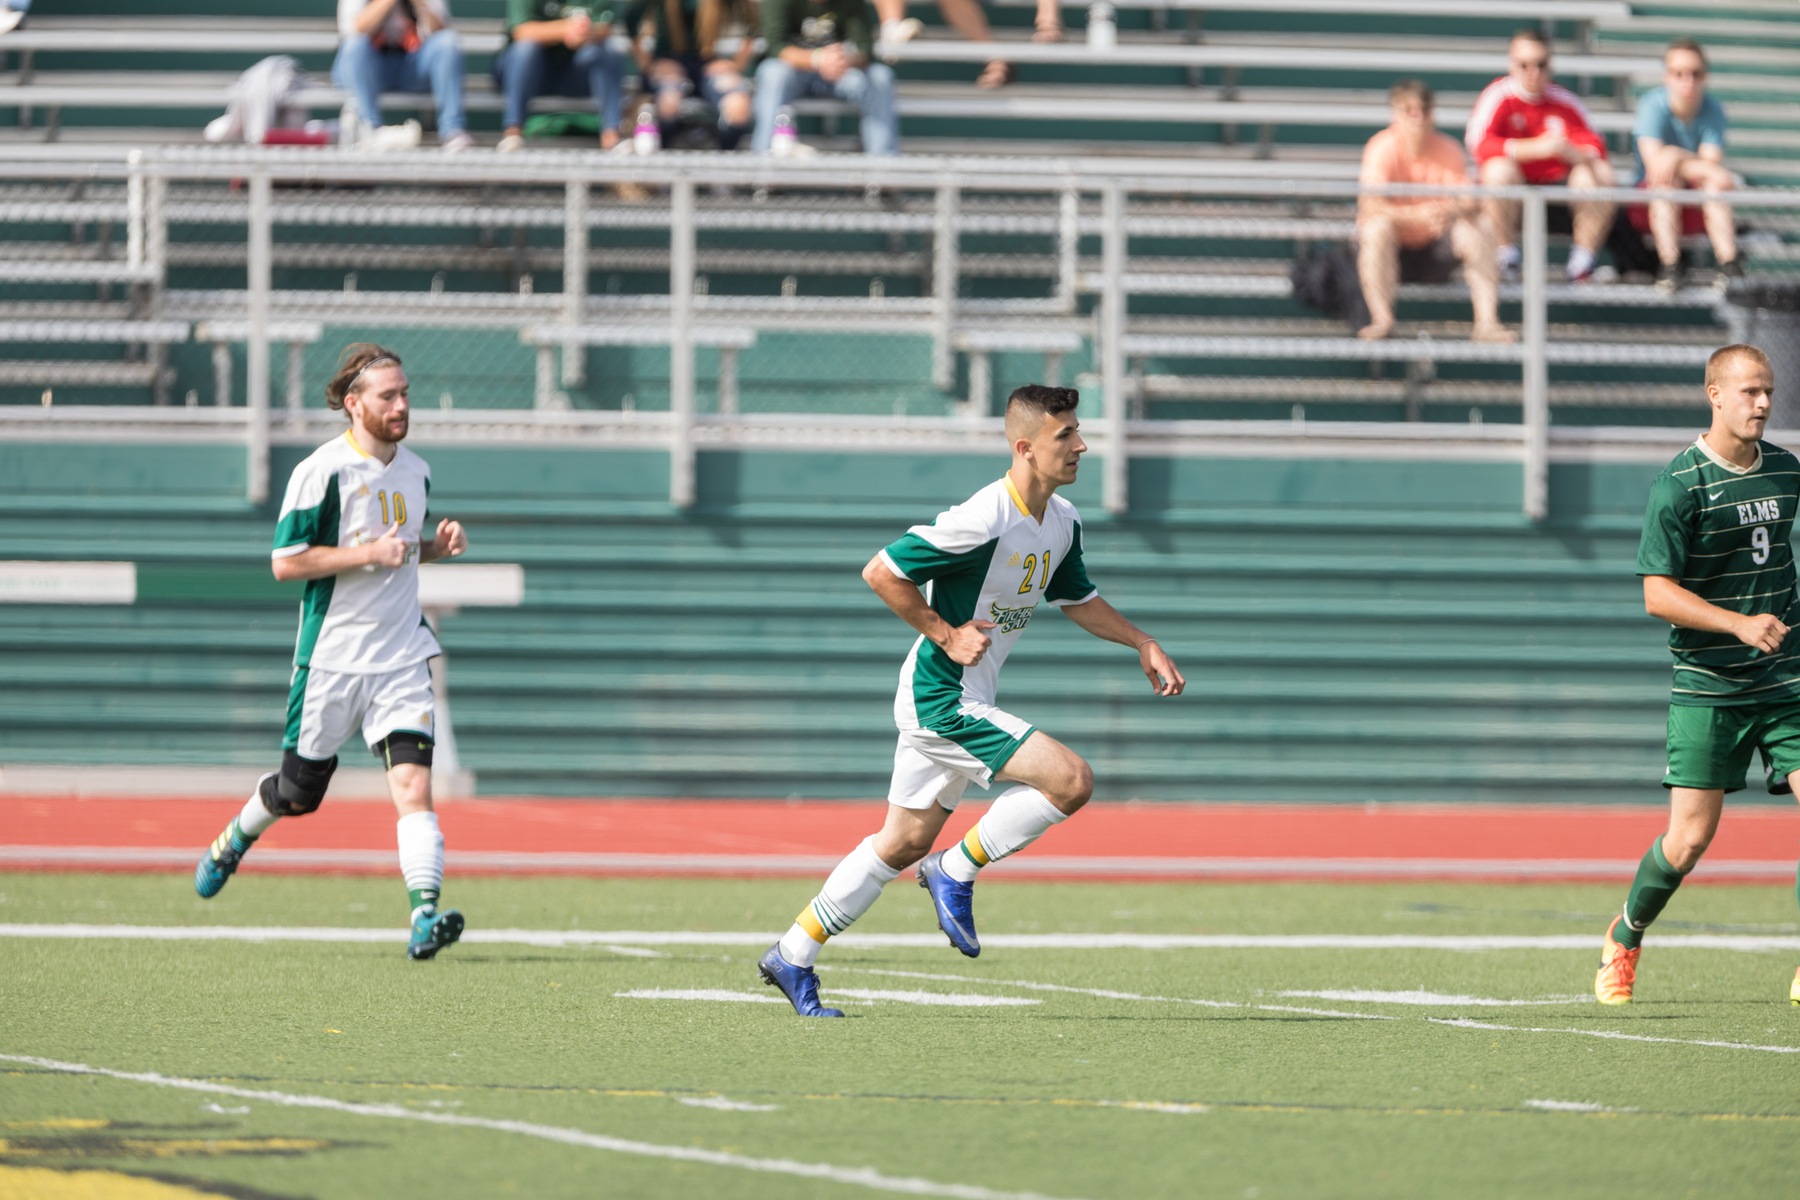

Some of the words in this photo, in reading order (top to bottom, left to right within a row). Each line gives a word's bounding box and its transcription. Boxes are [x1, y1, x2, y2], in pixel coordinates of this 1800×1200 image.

[378, 488, 407, 526] 10
[1737, 500, 1780, 525] ELMS
[1751, 526, 1770, 565] 9
[1017, 549, 1051, 595] 21
[992, 602, 1035, 624] FITCHB
